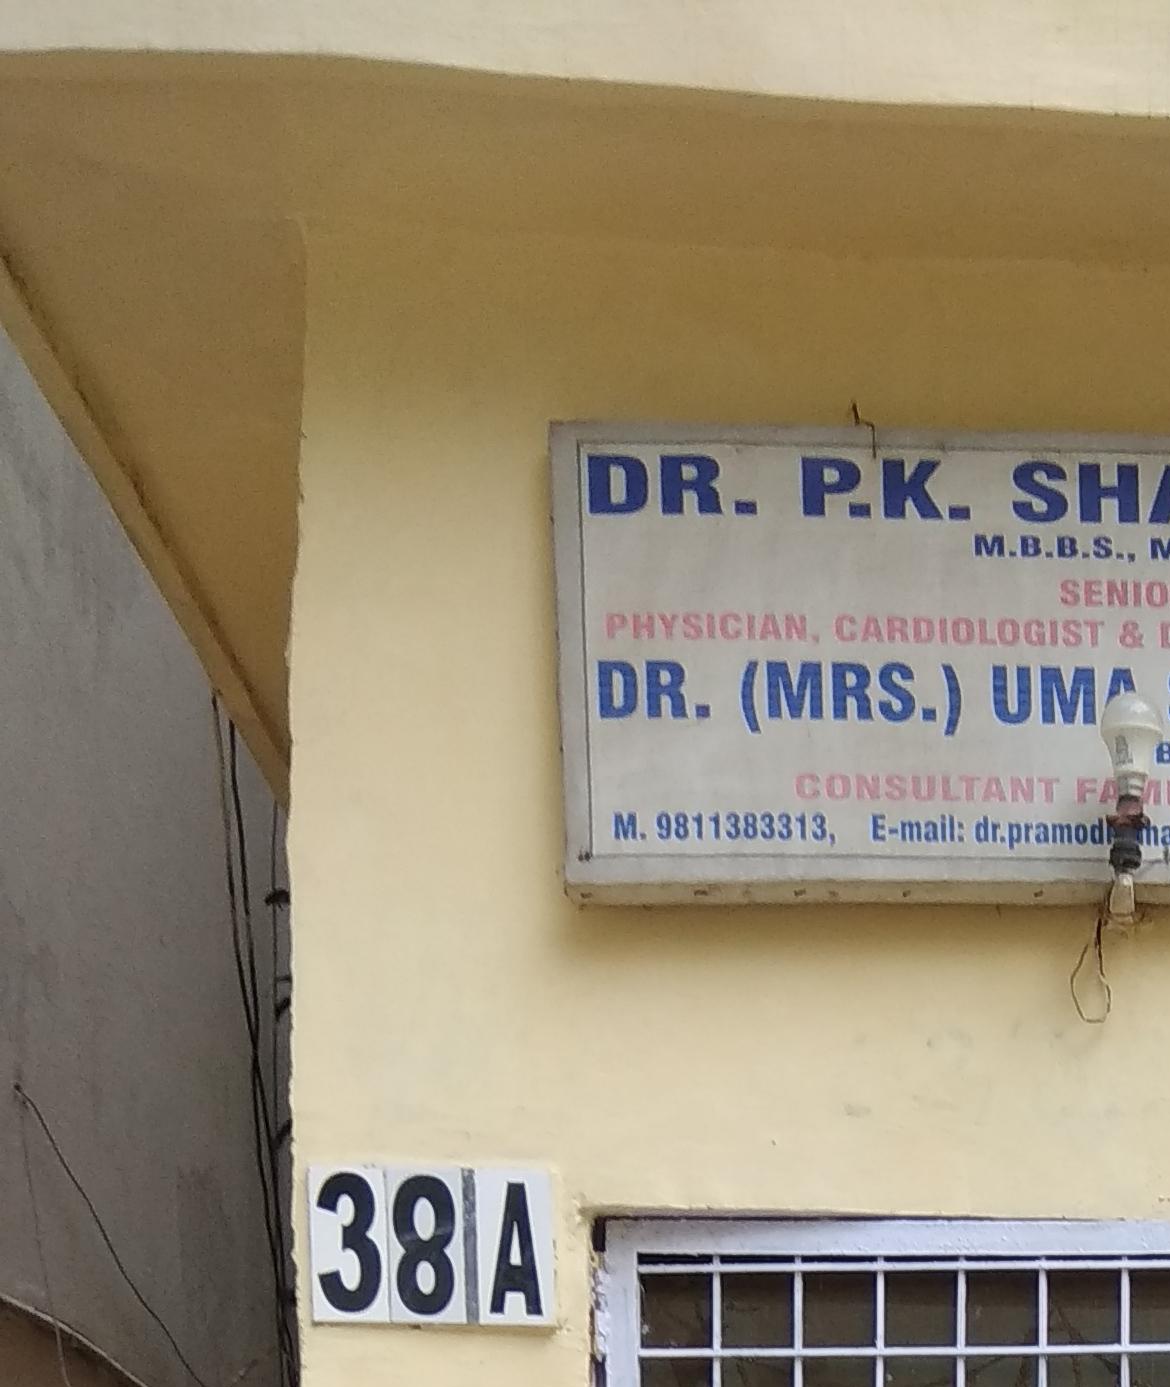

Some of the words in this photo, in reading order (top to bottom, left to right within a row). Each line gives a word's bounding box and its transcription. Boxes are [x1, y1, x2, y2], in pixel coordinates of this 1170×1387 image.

[586, 454, 758, 517] DR.
[800, 457, 972, 520] P.K.
[974, 534, 1136, 563] M.B.B.S.,
[605, 611, 820, 644] PHYSICIAN,
[834, 614, 1104, 649] CARDIOLOGIST
[1118, 620, 1145, 650] &
[597, 659, 711, 721] DR.
[740, 659, 962, 736] (MRS.)
[794, 773, 1060, 804] CONSULTANT
[613, 812, 646, 841] M.
[656, 812, 836, 845] 9811383313,
[871, 814, 965, 845] E-mail:
